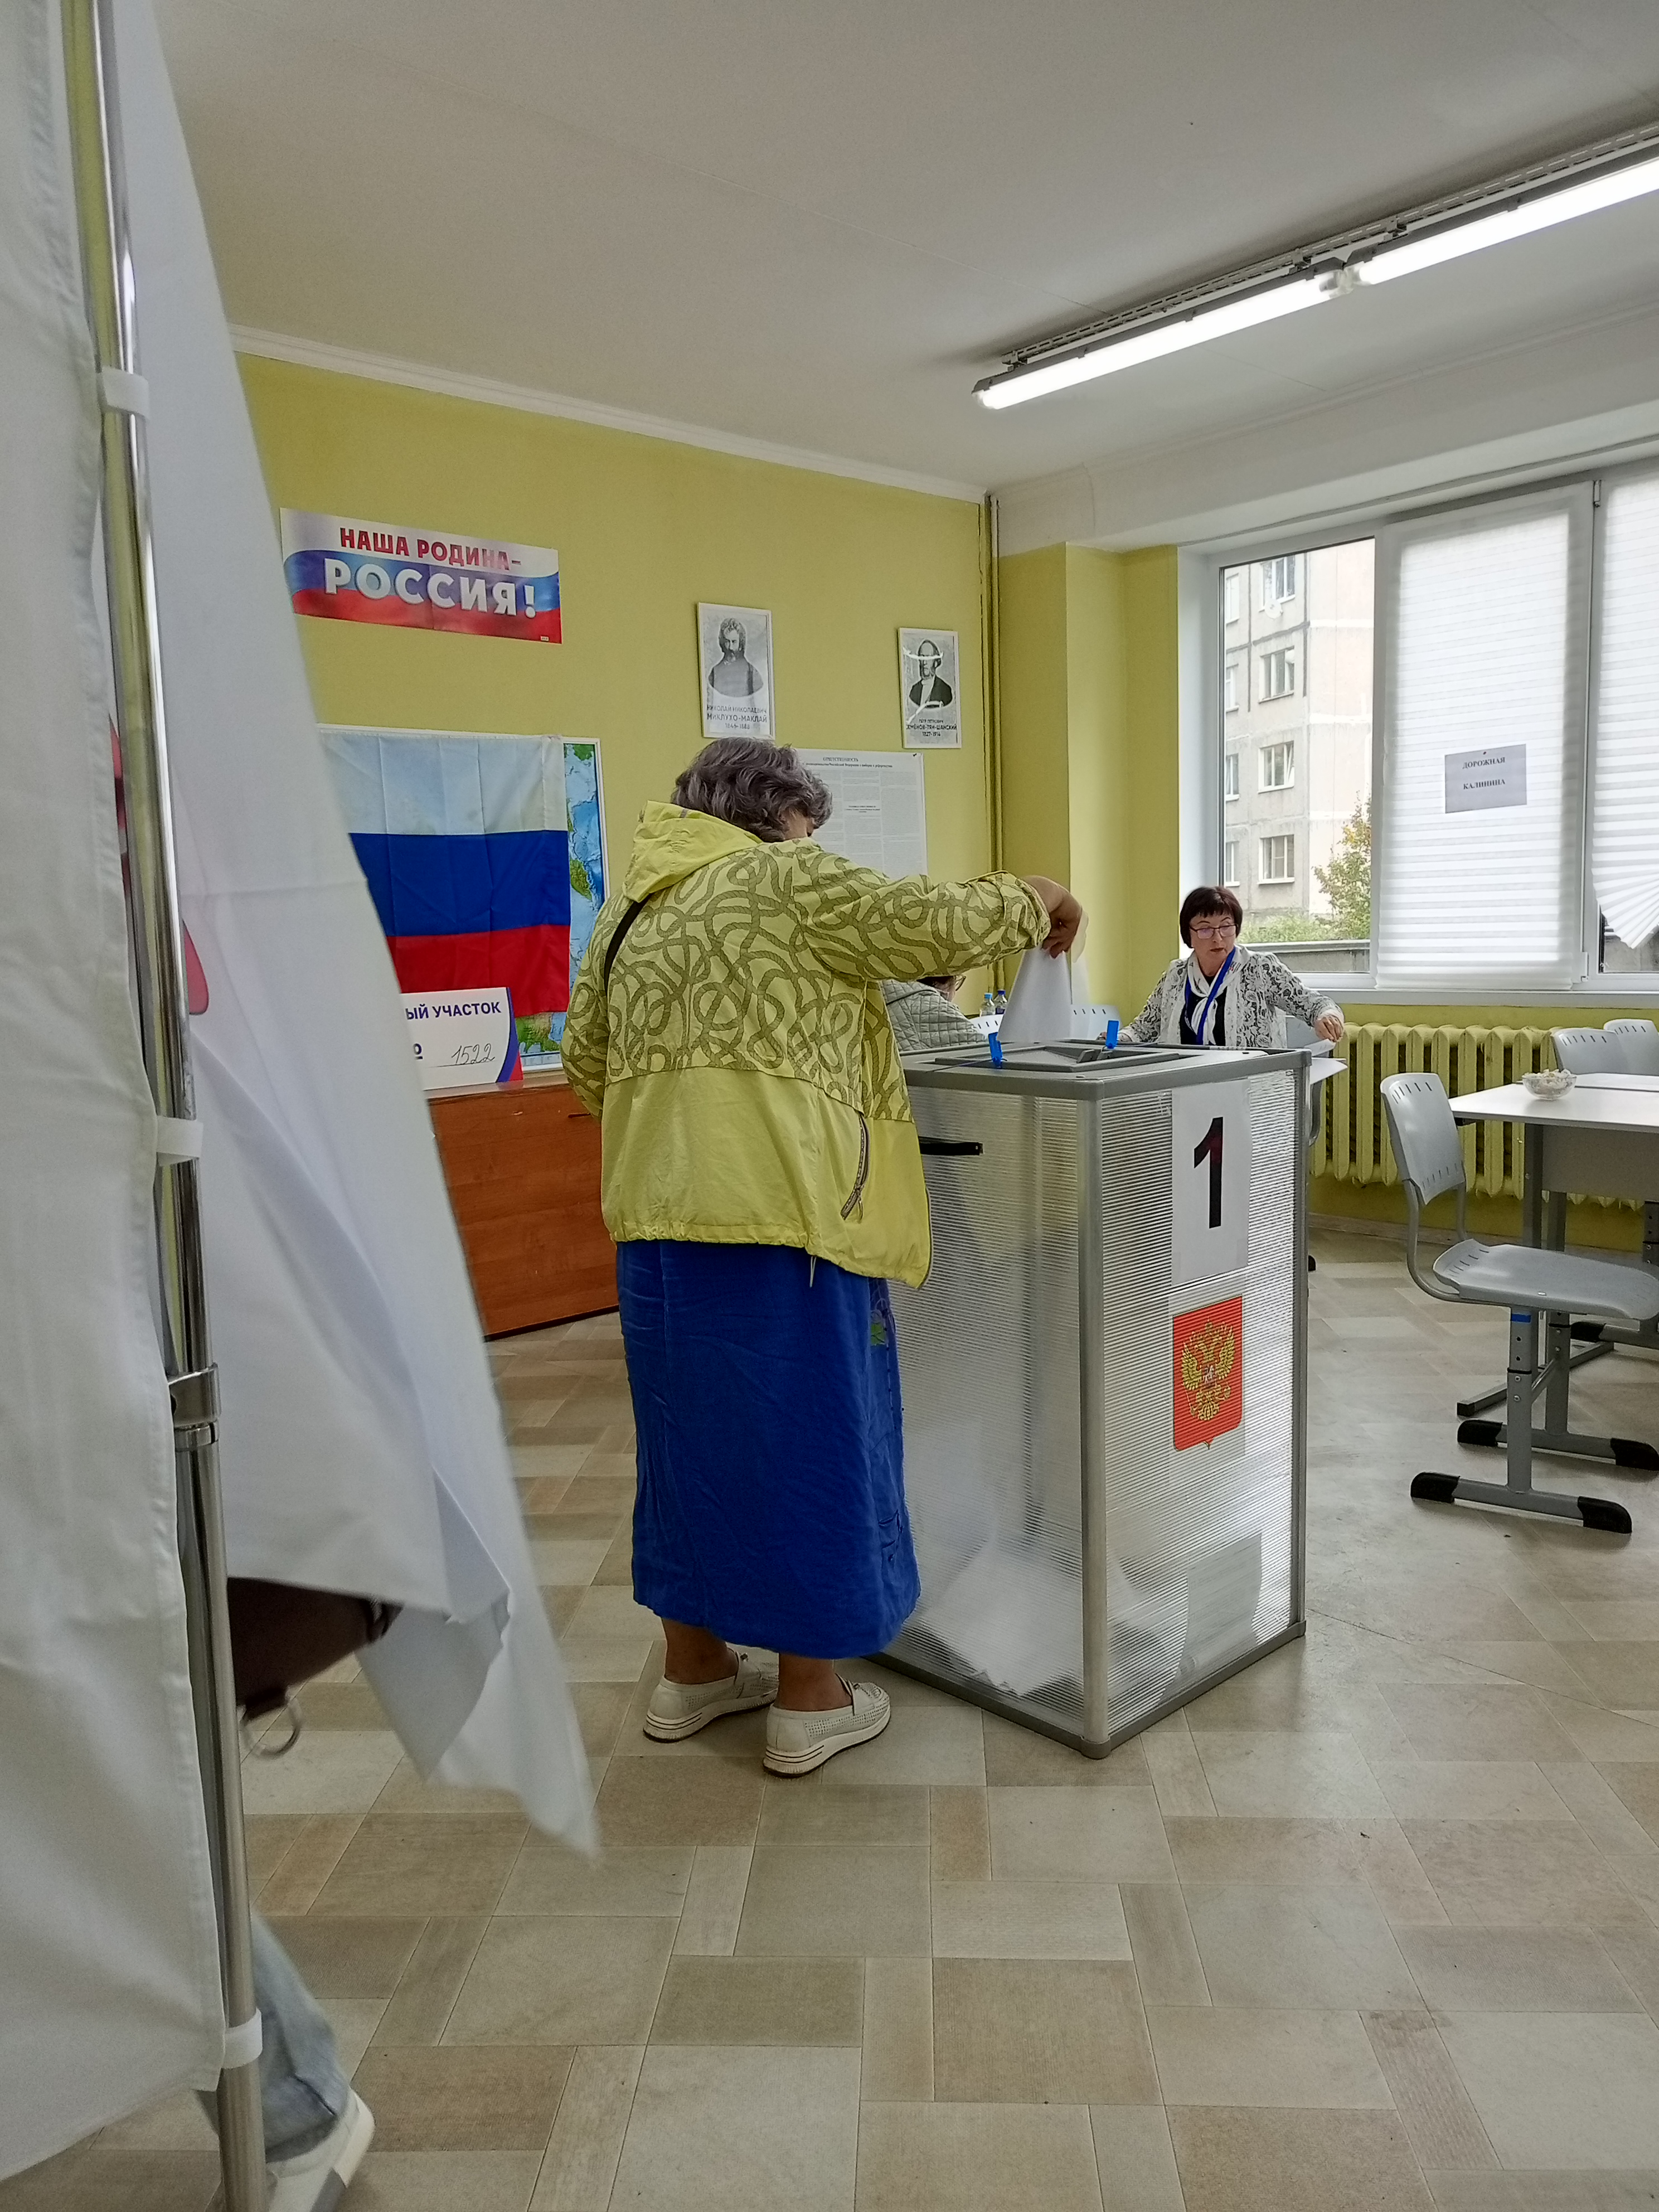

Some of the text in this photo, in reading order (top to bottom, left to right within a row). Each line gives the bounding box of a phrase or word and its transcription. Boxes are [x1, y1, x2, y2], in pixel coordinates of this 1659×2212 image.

[340, 527, 410, 557] НАША
[324, 558, 537, 619] РОССИЯ!
[1462, 756, 1505, 769] ДОРОЖНАЯ
[1463, 779, 1506, 790] КАЛИНИНА
[432, 1001, 501, 1018] УЧАСТОК
[451, 1043, 496, 1065] 1522
[1194, 1117, 1224, 1229] 1
